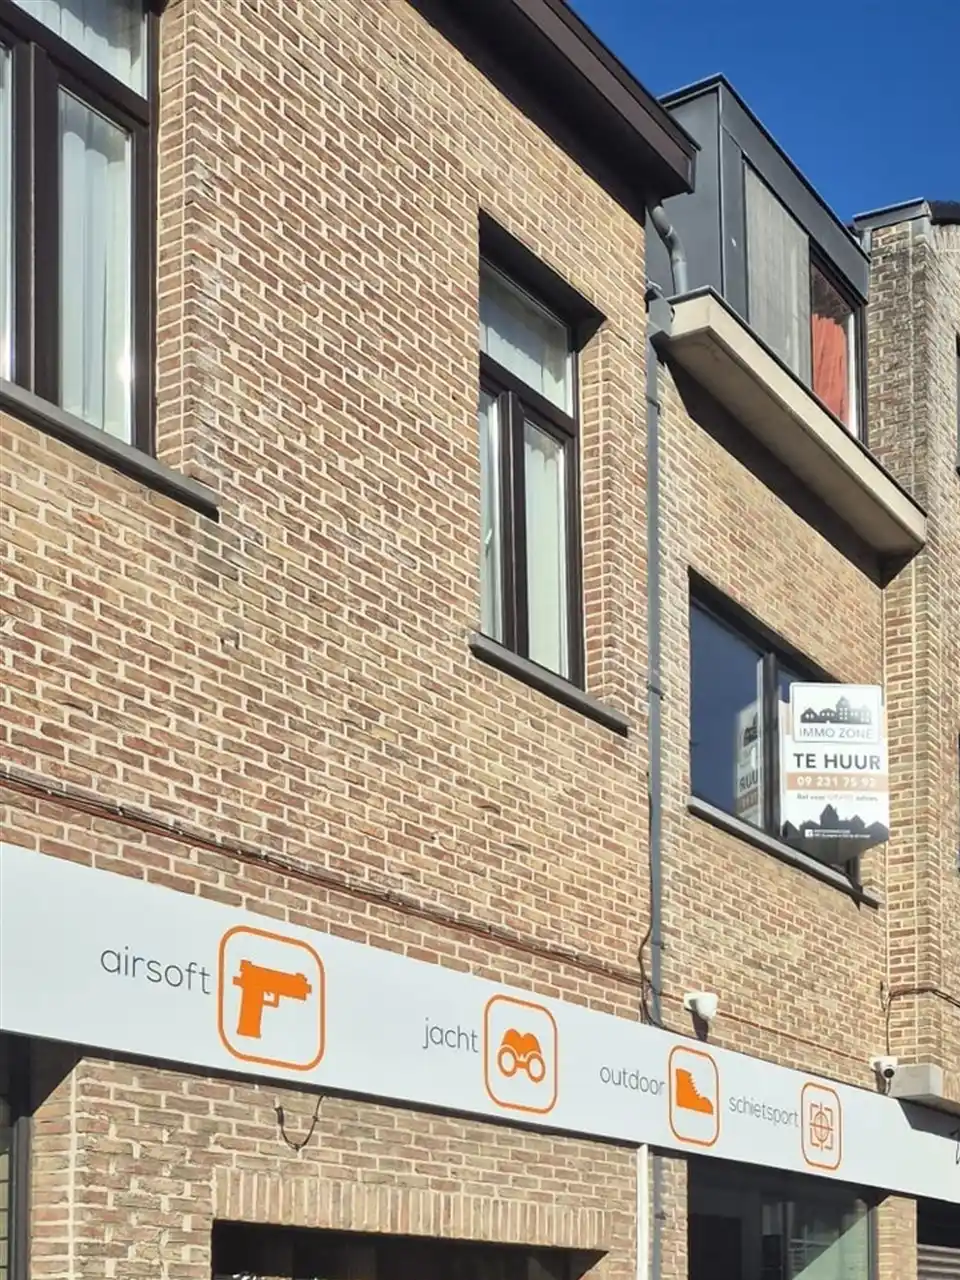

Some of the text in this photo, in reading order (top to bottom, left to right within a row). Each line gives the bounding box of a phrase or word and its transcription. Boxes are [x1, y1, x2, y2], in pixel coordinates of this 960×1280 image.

[799, 727, 875, 739] IMMO ZONE
[793, 752, 881, 770] TE HUUR
[796, 775, 813, 788] 09
[100, 945, 212, 995] airsoft
[421, 1017, 479, 1053] jacht
[599, 1065, 666, 1096] outdoor
[728, 1095, 799, 1129] schietsport
